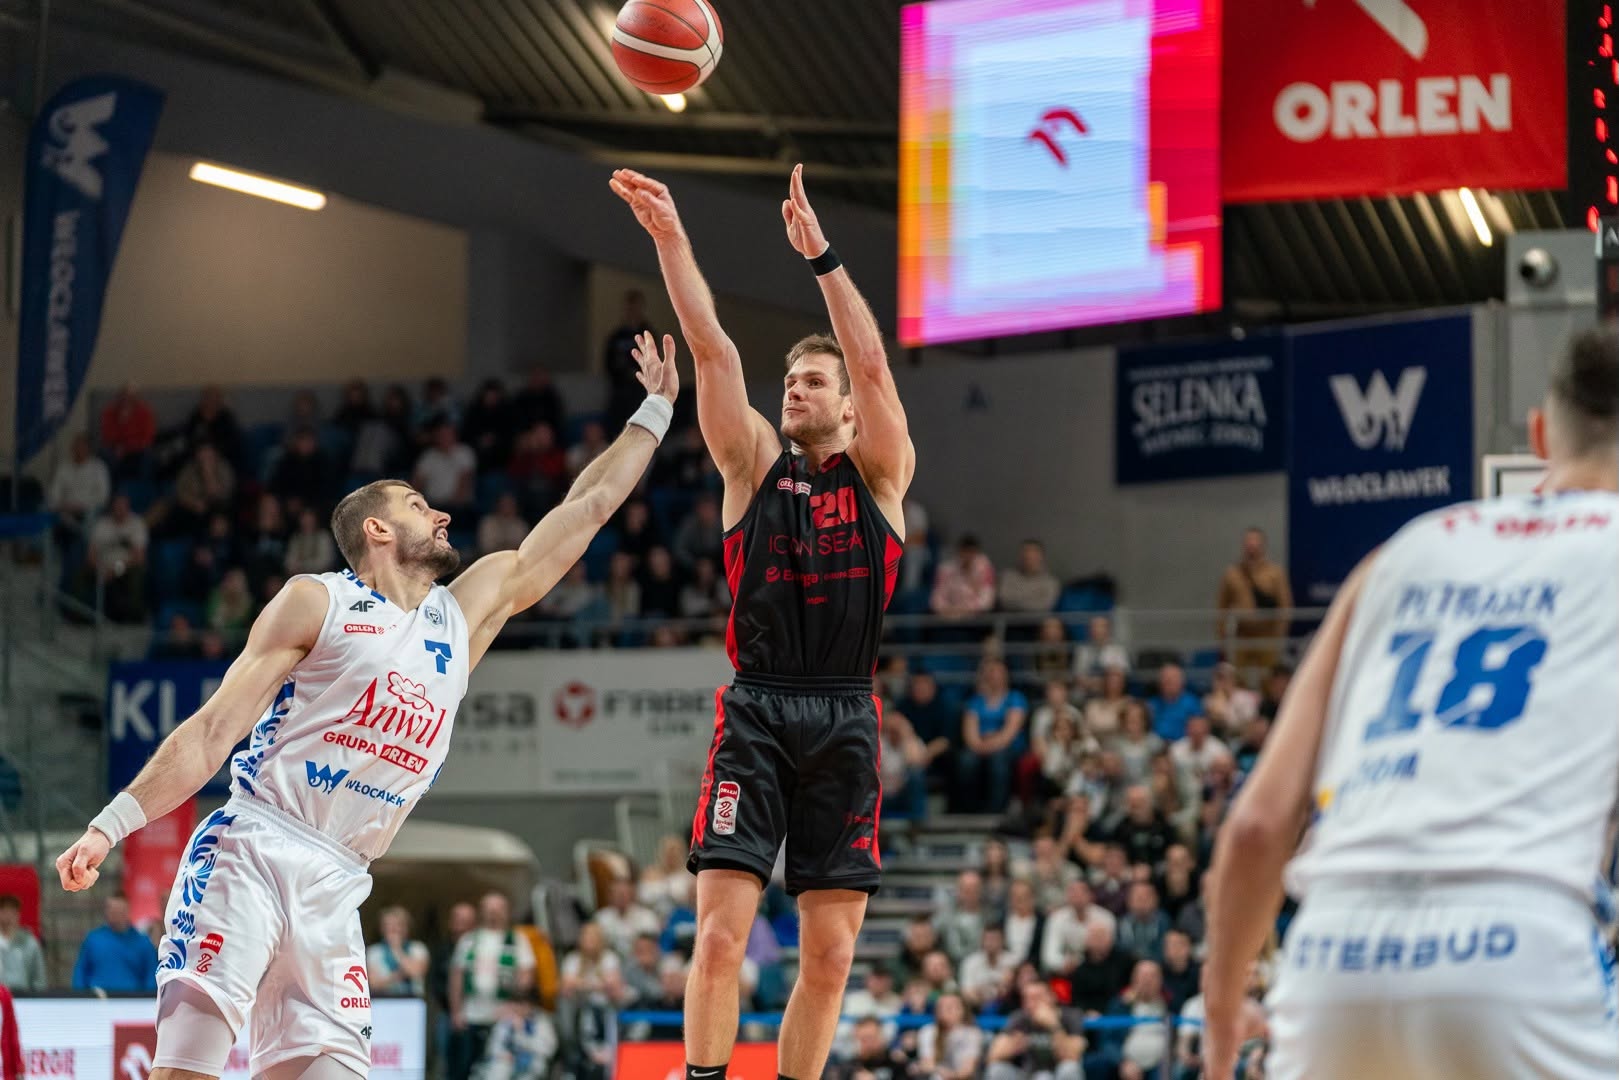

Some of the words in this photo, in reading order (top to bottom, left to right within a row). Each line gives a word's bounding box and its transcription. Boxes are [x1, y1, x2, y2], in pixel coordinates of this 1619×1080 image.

[1273, 73, 1512, 143] ORLEN
[809, 486, 858, 529] 20
[818, 528, 865, 555] SEA
[349, 600, 376, 612] 4F
[346, 624, 375, 633] ORLEN
[1364, 625, 1548, 743] 18
[333, 676, 447, 749] Anwil
[323, 731, 378, 756] GRUPA
[381, 744, 426, 773] ORLEN
